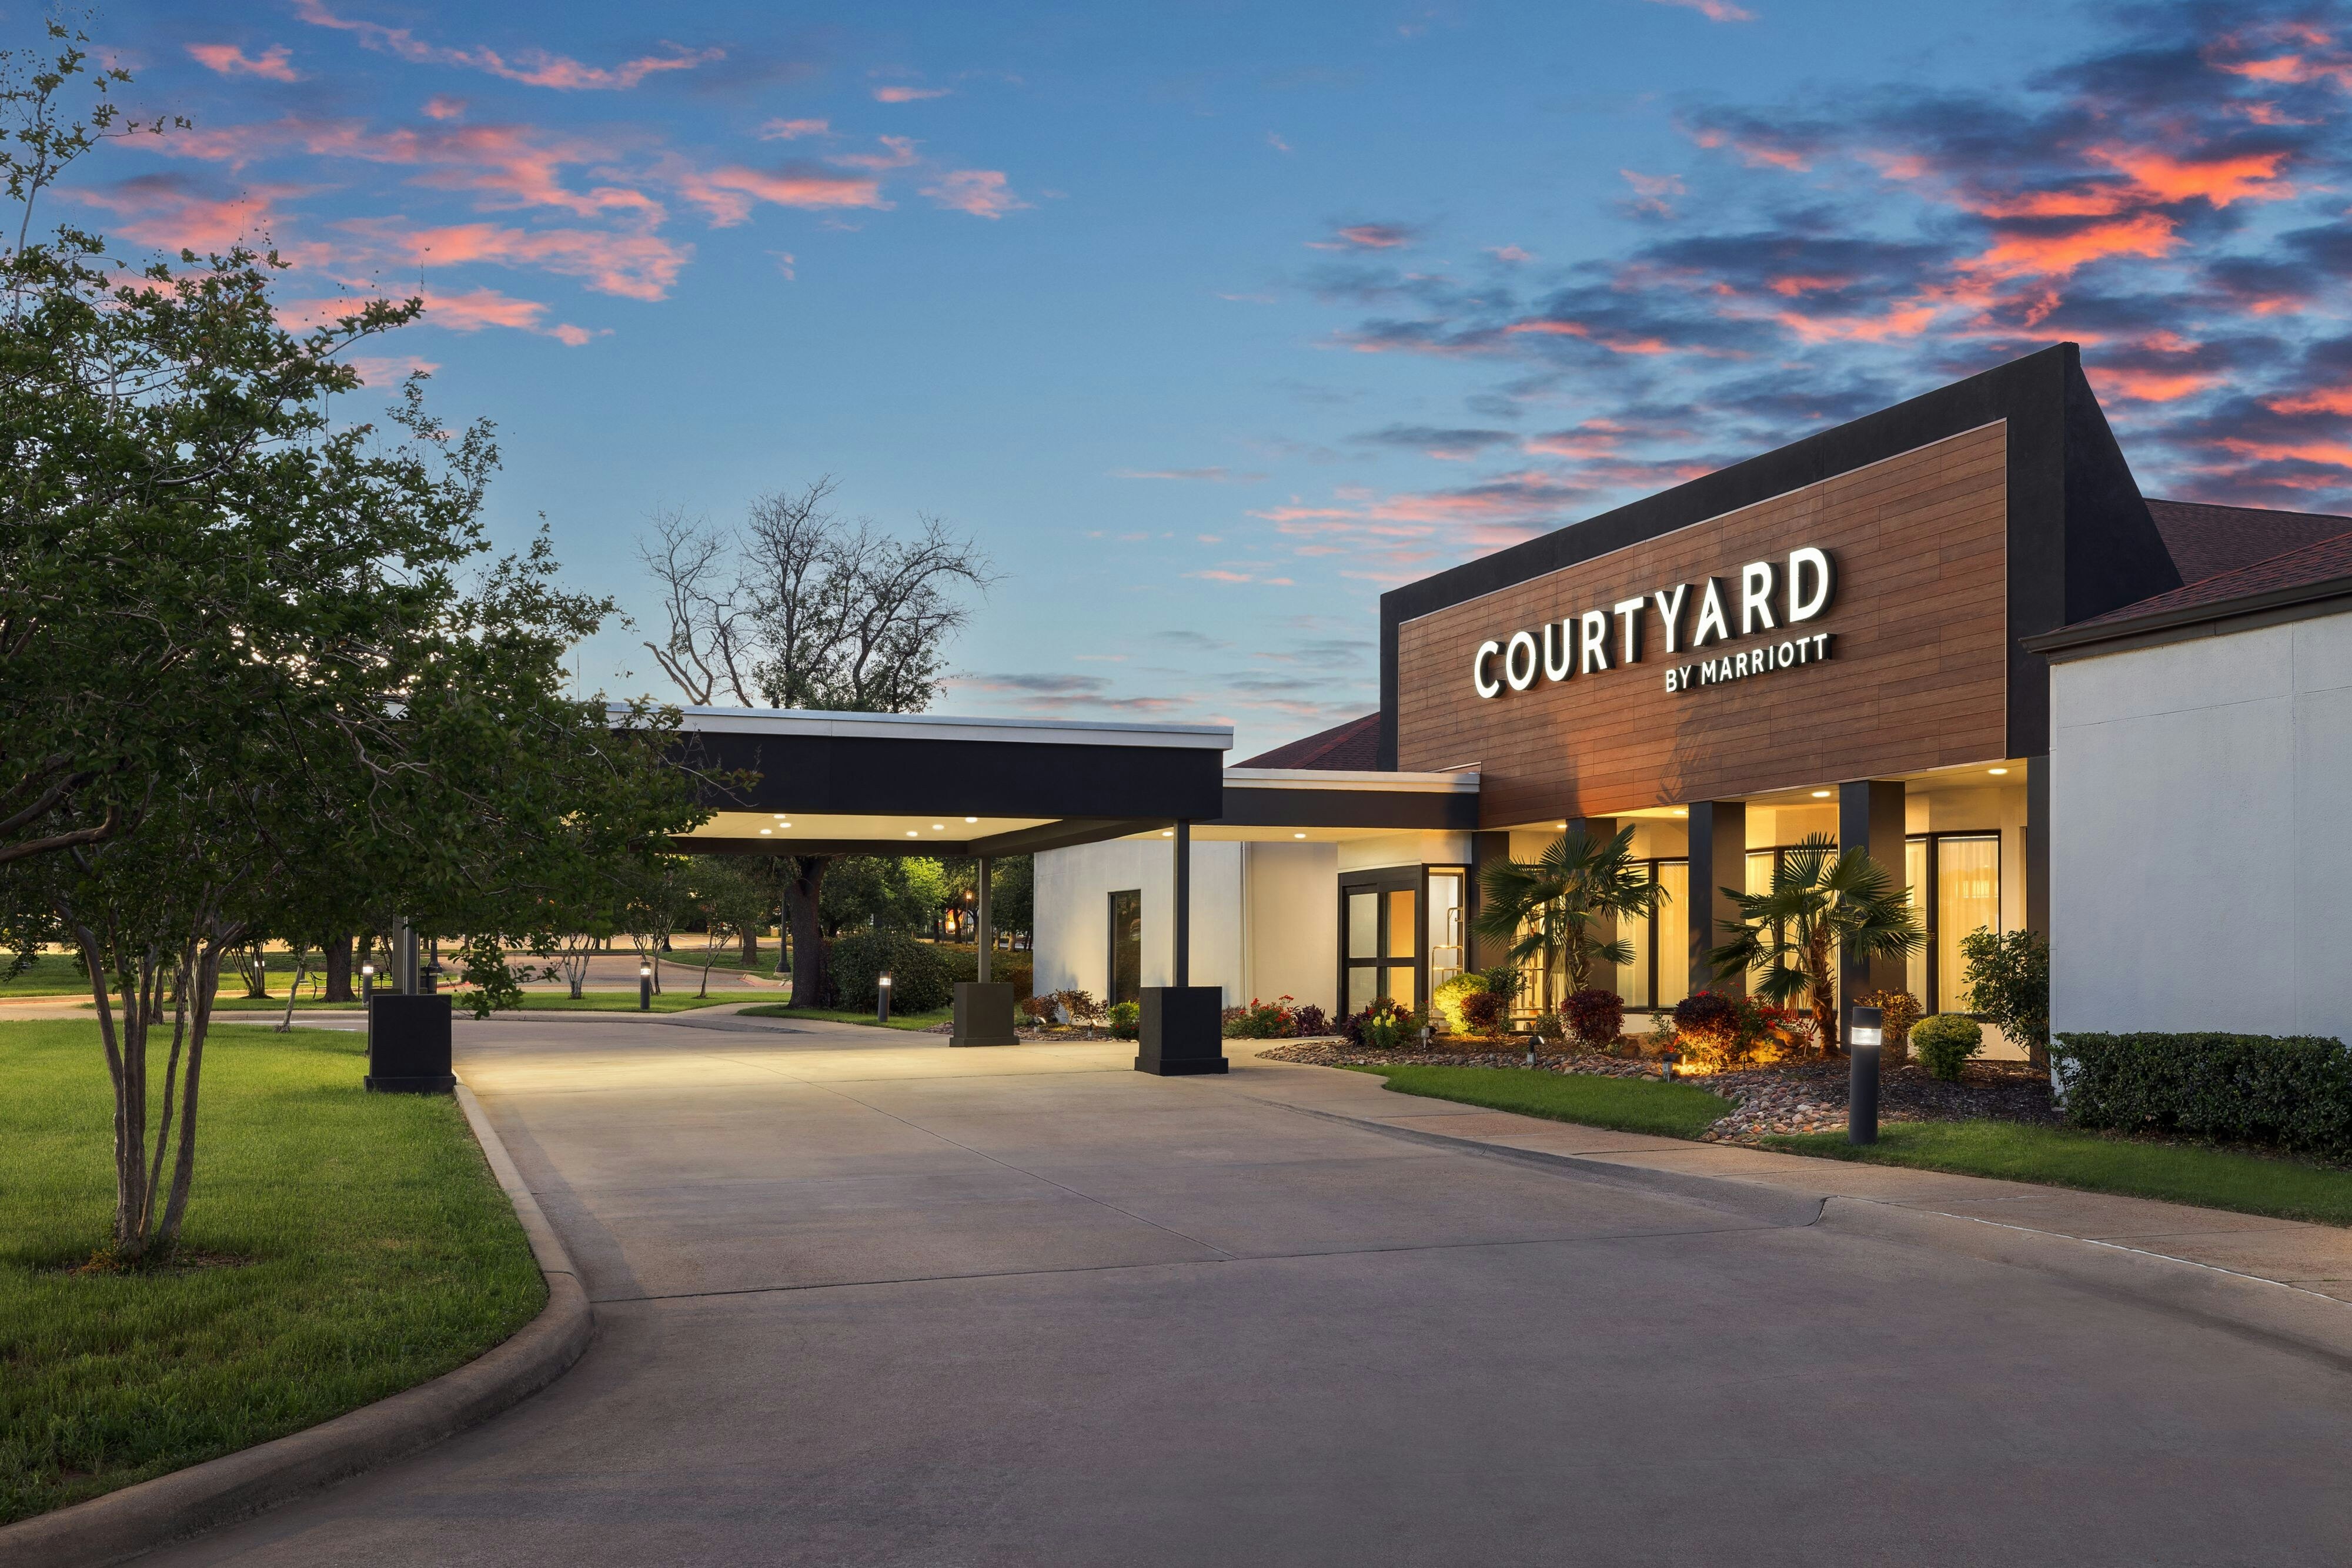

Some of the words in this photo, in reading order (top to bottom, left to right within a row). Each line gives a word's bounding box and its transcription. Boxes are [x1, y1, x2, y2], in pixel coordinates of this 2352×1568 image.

[1474, 547, 1830, 699] COURTYARD
[1665, 665, 1692, 693] BY
[1701, 633, 1828, 685] MARRIOTT
